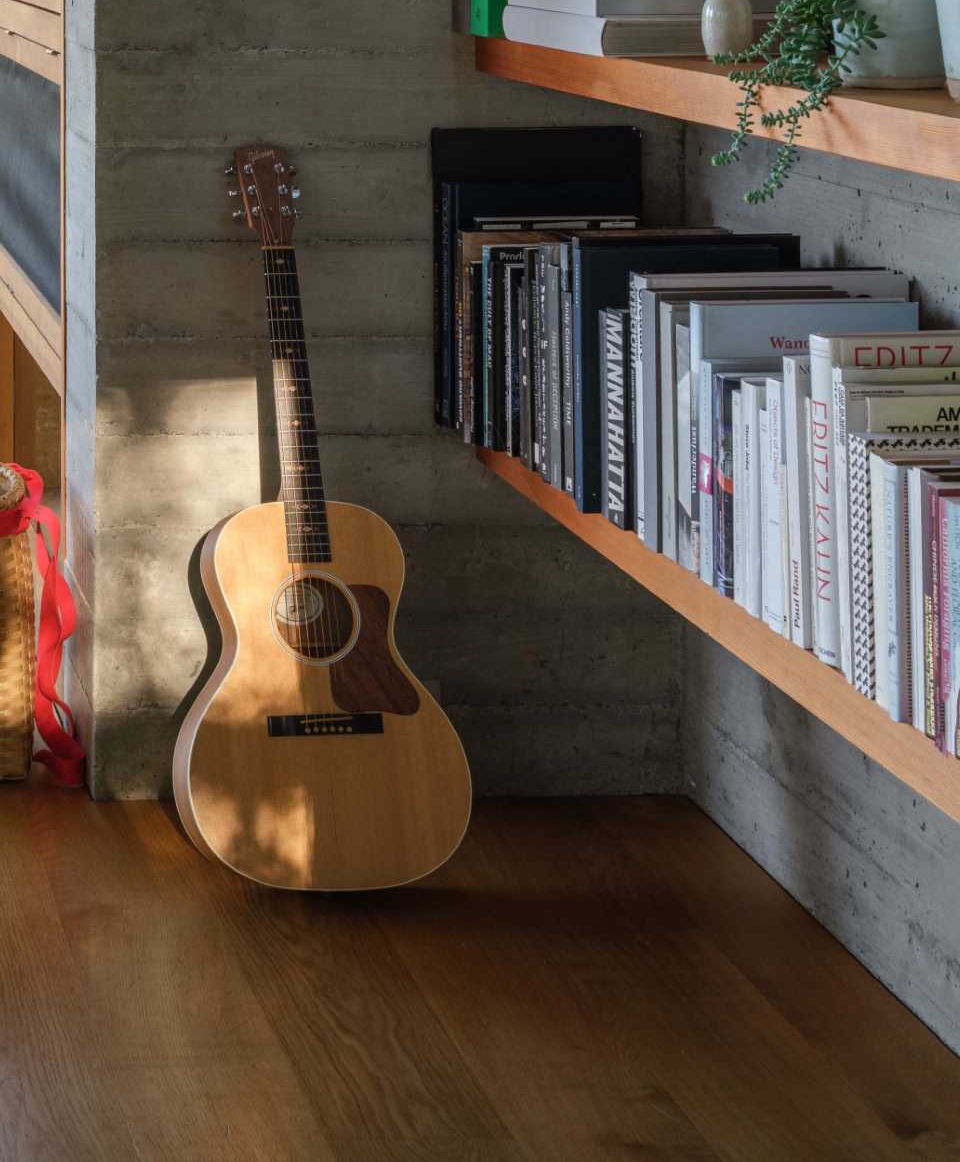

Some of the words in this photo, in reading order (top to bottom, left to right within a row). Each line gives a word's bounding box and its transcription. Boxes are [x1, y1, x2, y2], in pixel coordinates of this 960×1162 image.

[564, 300, 572, 325] Andy
[551, 330, 559, 368] Masters
[565, 327, 573, 388] Goldsworthy
[552, 382, 560, 431] DECEPTION
[607, 317, 625, 514] MANNAHATTA
[690, 425, 698, 495] Wanderlust
[792, 559, 800, 597] Rand
[792, 599, 801, 629] Paul
